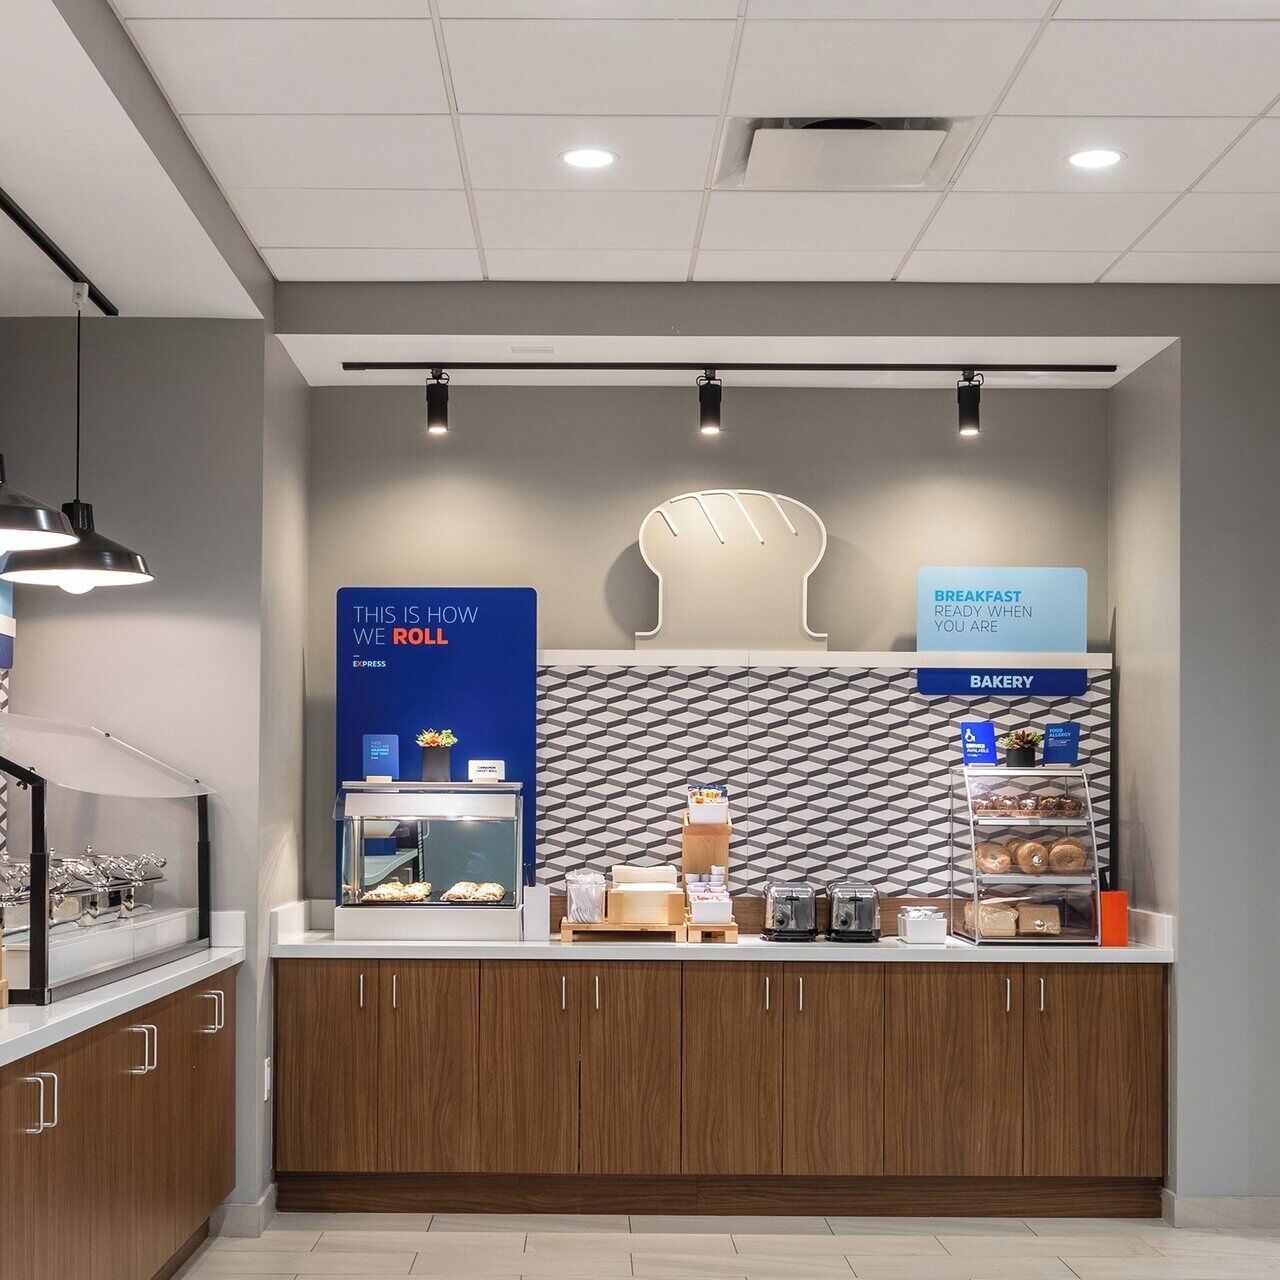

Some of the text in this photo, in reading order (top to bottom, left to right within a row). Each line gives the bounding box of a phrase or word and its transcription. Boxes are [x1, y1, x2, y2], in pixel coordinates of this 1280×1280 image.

[934, 590, 1022, 602] BREAKFAST
[353, 605, 479, 624] THIS IS HOW
[934, 605, 1032, 618] READY WHEN
[934, 620, 998, 632] YOU ARE
[353, 627, 449, 645] WE ROLL
[970, 675, 1034, 688] BAKERY
